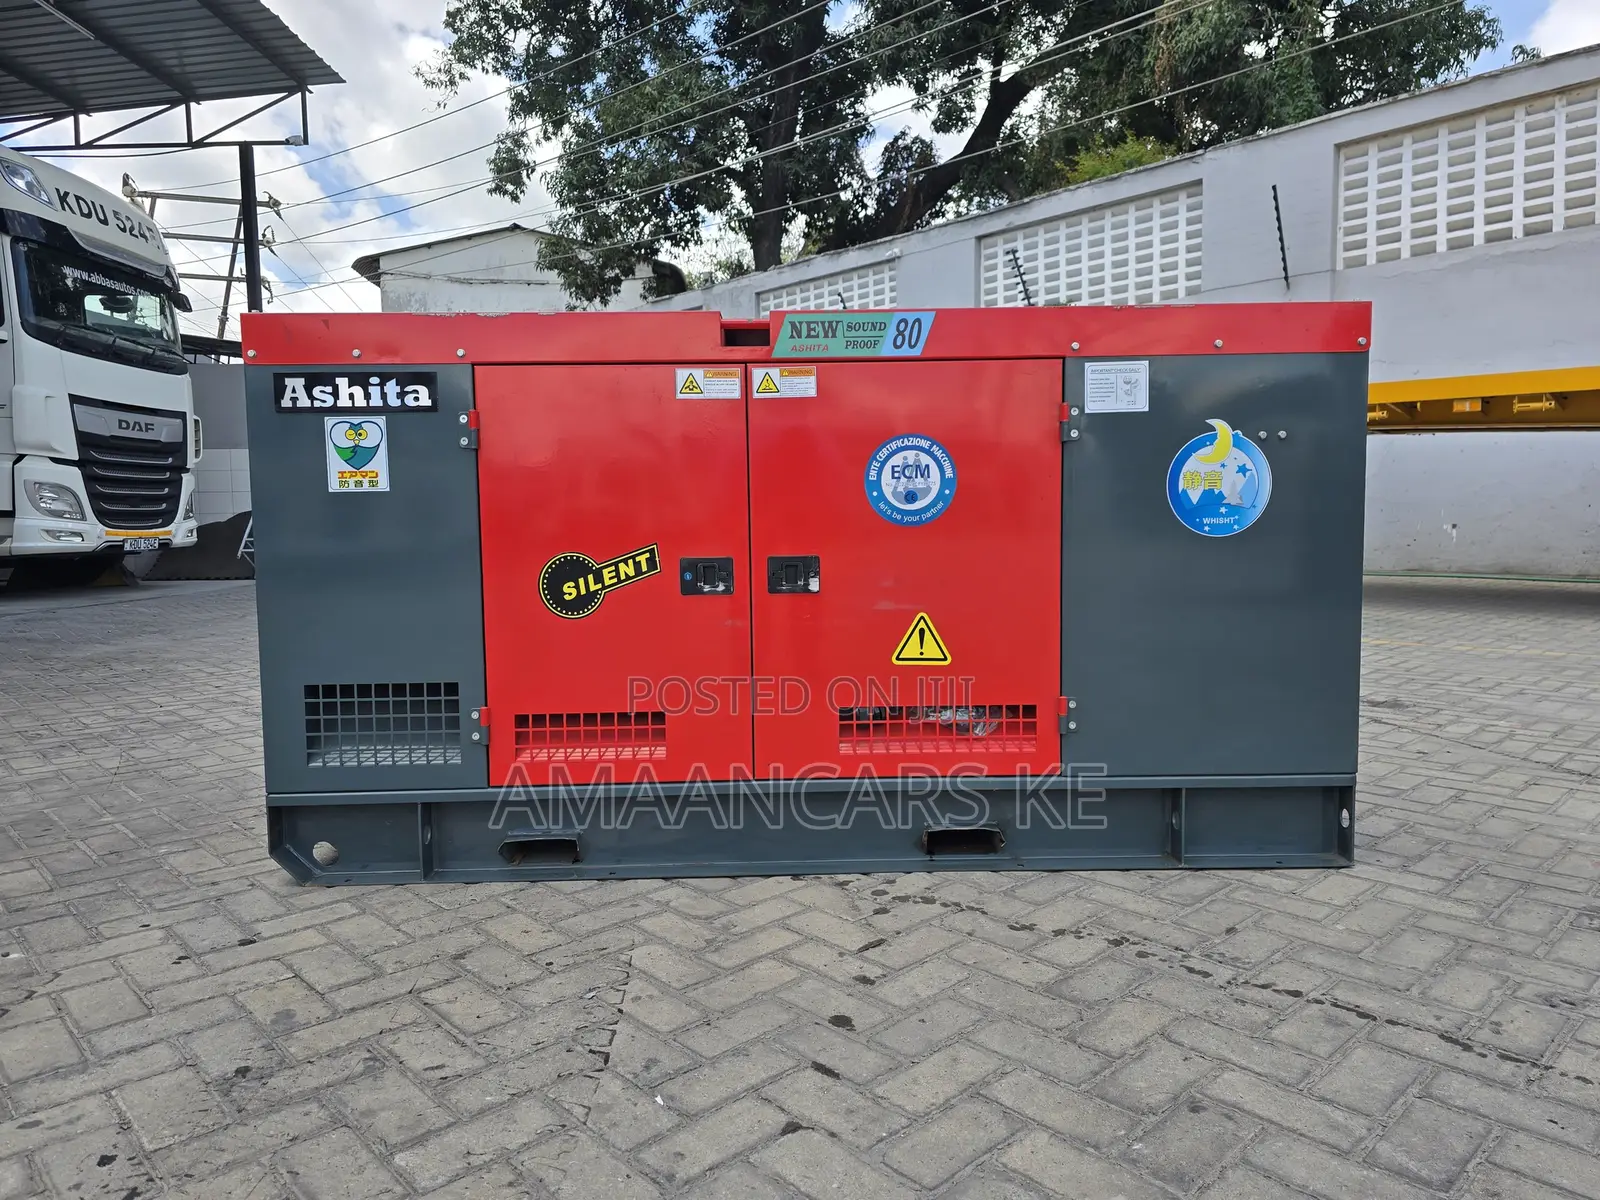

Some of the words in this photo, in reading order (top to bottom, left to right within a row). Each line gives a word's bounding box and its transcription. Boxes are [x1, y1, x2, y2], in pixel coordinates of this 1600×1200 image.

[55, 187, 109, 227] KDU
[61, 265, 152, 297] www.abbasautos.com
[788, 320, 840, 339] NEW
[845, 321, 887, 332] SOUND
[892, 317, 923, 350] 80
[790, 343, 829, 352] ASHITA
[845, 339, 880, 350] PROOF
[280, 376, 432, 408] Ashita
[117, 418, 155, 433] DAF
[868, 460, 881, 481] ENTE
[876, 437, 931, 462] CERTIFICAZIONE
[930, 444, 954, 479] MACCHINE
[890, 464, 931, 480] ECM
[338, 480, 379, 489] 防音型
[1183, 470, 1223, 490] 静音
[878, 500, 891, 515] let's
[892, 511, 902, 520] be
[903, 515, 920, 523] your
[921, 500, 945, 521] partner
[562, 552, 651, 601] SILENT
